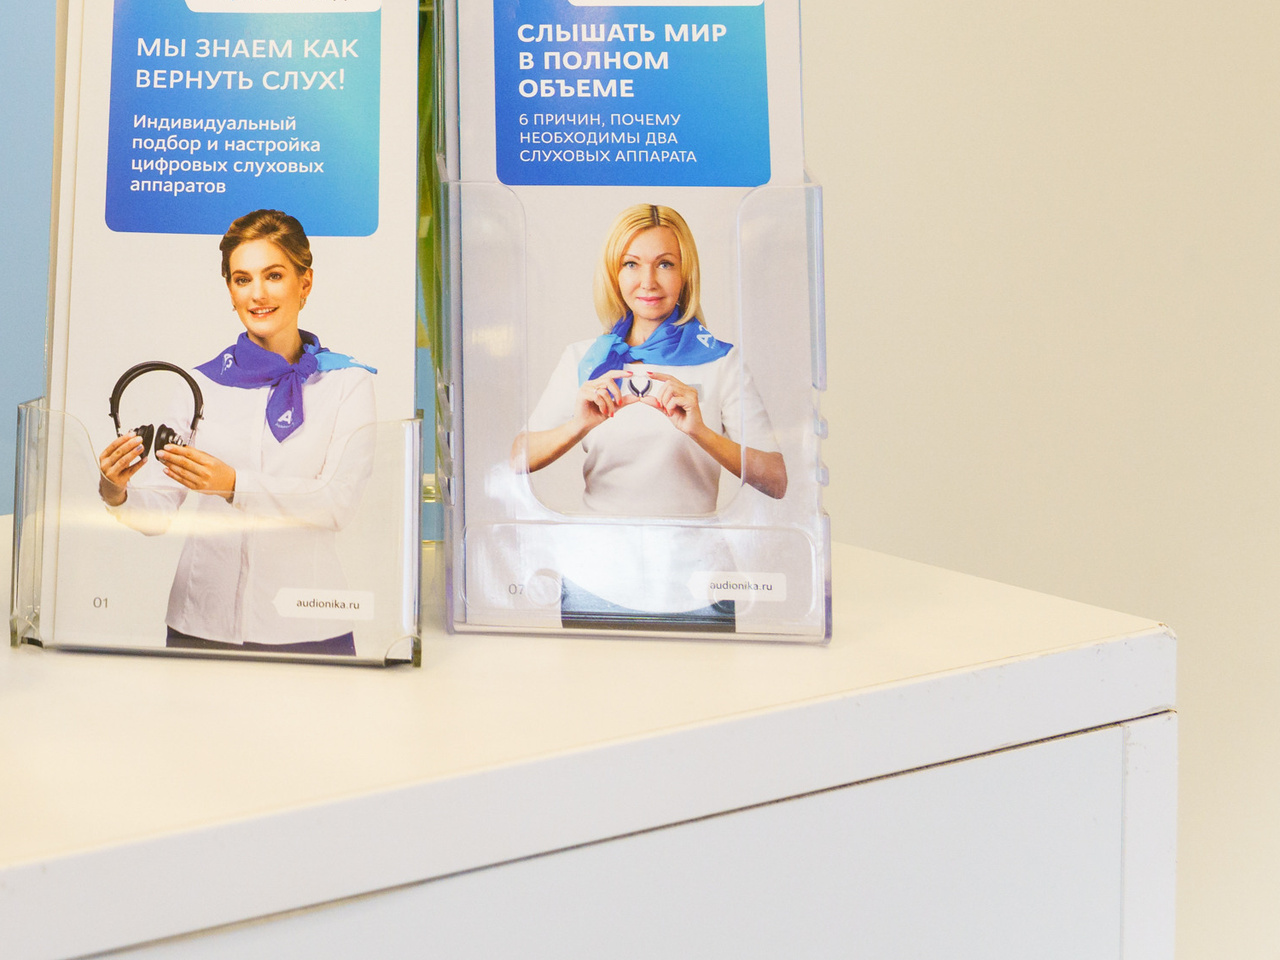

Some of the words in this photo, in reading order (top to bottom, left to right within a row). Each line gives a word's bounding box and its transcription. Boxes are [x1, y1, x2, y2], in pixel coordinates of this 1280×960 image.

[517, 23, 655, 42] СЛЫШАТЬ
[664, 24, 727, 42] МИР
[137, 38, 186, 57] МЫ
[195, 38, 293, 58] ЗНАЕМ
[303, 39, 359, 58] КАК
[519, 52, 534, 69] В
[544, 51, 669, 70] ПОЛНОМ
[135, 69, 254, 90] ВЕРНУТЬ
[262, 68, 345, 91] СЛУХ!
[518, 79, 635, 98] ОБЪЕМЕ
[133, 114, 296, 134] Индивидуальный
[519, 113, 529, 126] 6
[533, 113, 605, 128] ПРИЧИН,
[610, 113, 682, 126] ПОЧЕМУ
[132, 134, 201, 154] подбор
[207, 139, 218, 151] и
[224, 137, 321, 155] настройка
[519, 131, 640, 145] НЕОБХОДИМЫ
[645, 132, 678, 146] ДВА
[519, 150, 611, 162] СЛУХОВЫХ
[614, 150, 697, 163] АППАРАТА
[131, 156, 228, 175] цифровых
[233, 159, 324, 177] слуховых
[130, 179, 226, 196] аппаратов
[508, 583, 525, 595] 07
[709, 580, 773, 591] audionika.ru
[91, 596, 109, 609] 01
[296, 598, 360, 611] audionika.ru
